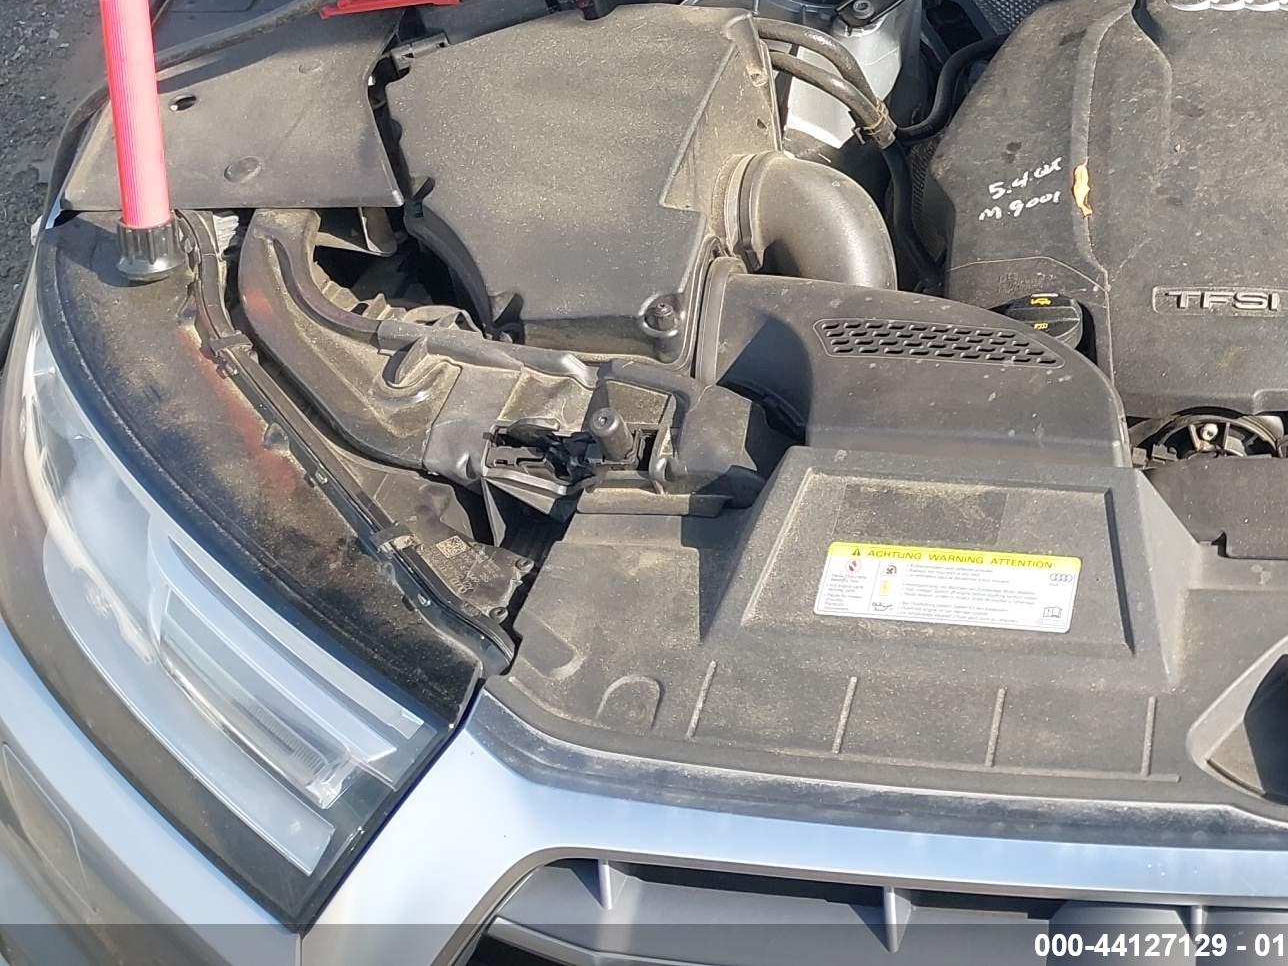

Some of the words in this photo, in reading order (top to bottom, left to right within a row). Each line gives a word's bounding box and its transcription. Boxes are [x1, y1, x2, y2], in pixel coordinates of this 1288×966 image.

[1164, 289, 1280, 312] TFSI
[867, 549, 922, 560] ACHTUNG
[928, 553, 984, 565] WARNING
[990, 557, 1054, 569] ATTENTION
